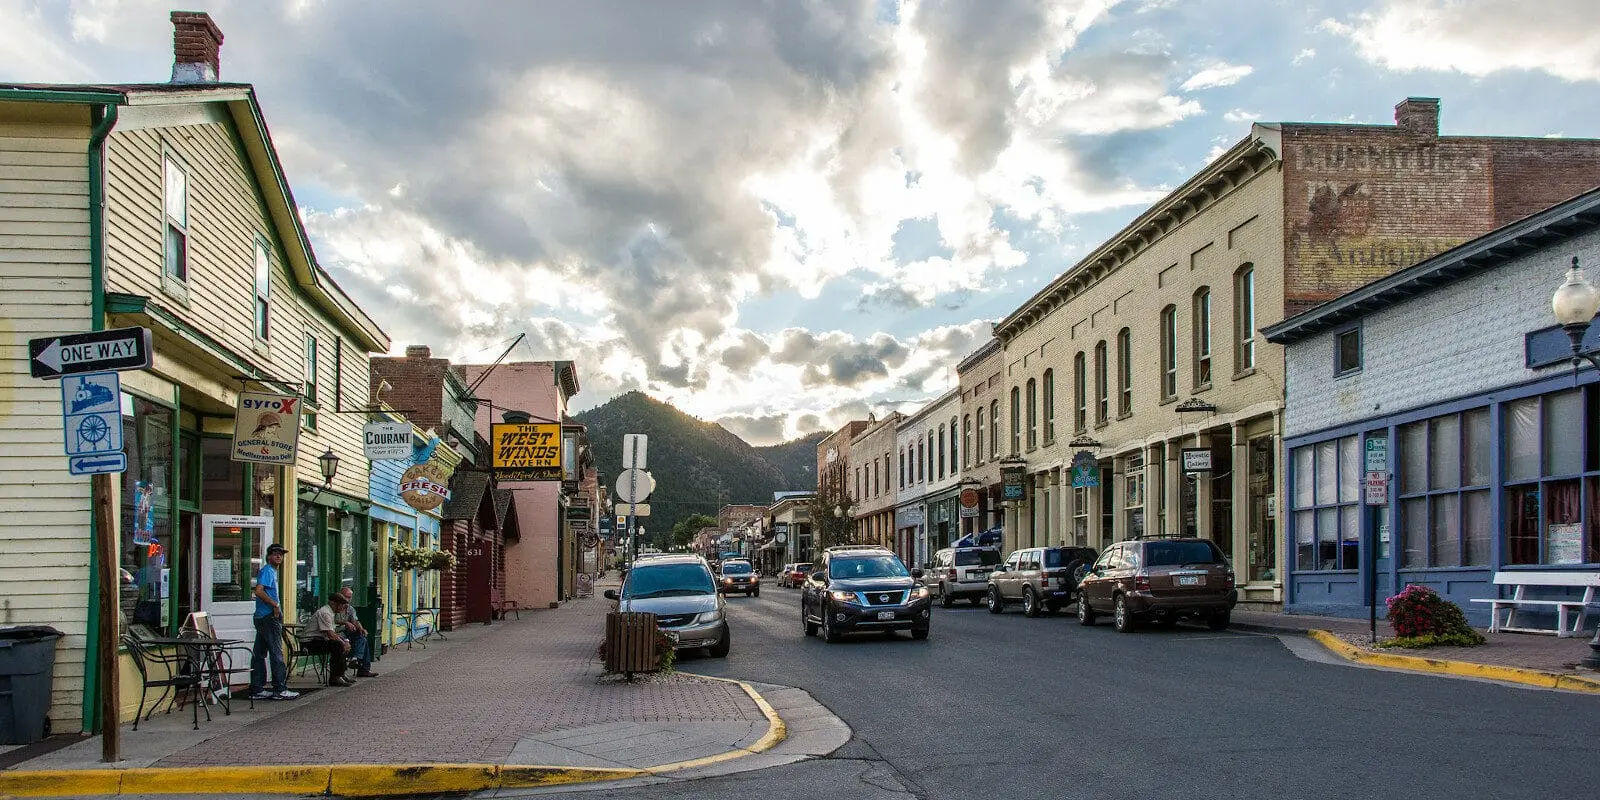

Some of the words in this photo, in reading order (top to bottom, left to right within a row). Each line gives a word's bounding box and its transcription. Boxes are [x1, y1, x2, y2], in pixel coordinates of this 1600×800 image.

[61, 346, 92, 362] ONE
[98, 340, 134, 358] WAY
[243, 398, 298, 414] gyroX
[500, 432, 553, 446] WEST
[237, 439, 270, 447] GENERAL
[270, 440, 293, 452] STORE
[260, 446, 269, 455] &
[1368, 441, 1373, 450] 3
[236, 448, 280, 460] Mediterranean
[498, 446, 559, 460] WINDS
[1185, 452, 1209, 460] Majestic
[503, 459, 552, 467] TAVERN
[407, 465, 443, 480] BAKED
[1372, 472, 1380, 480] NO
[401, 482, 448, 497] FRESH
[410, 495, 437, 505] DAILY
